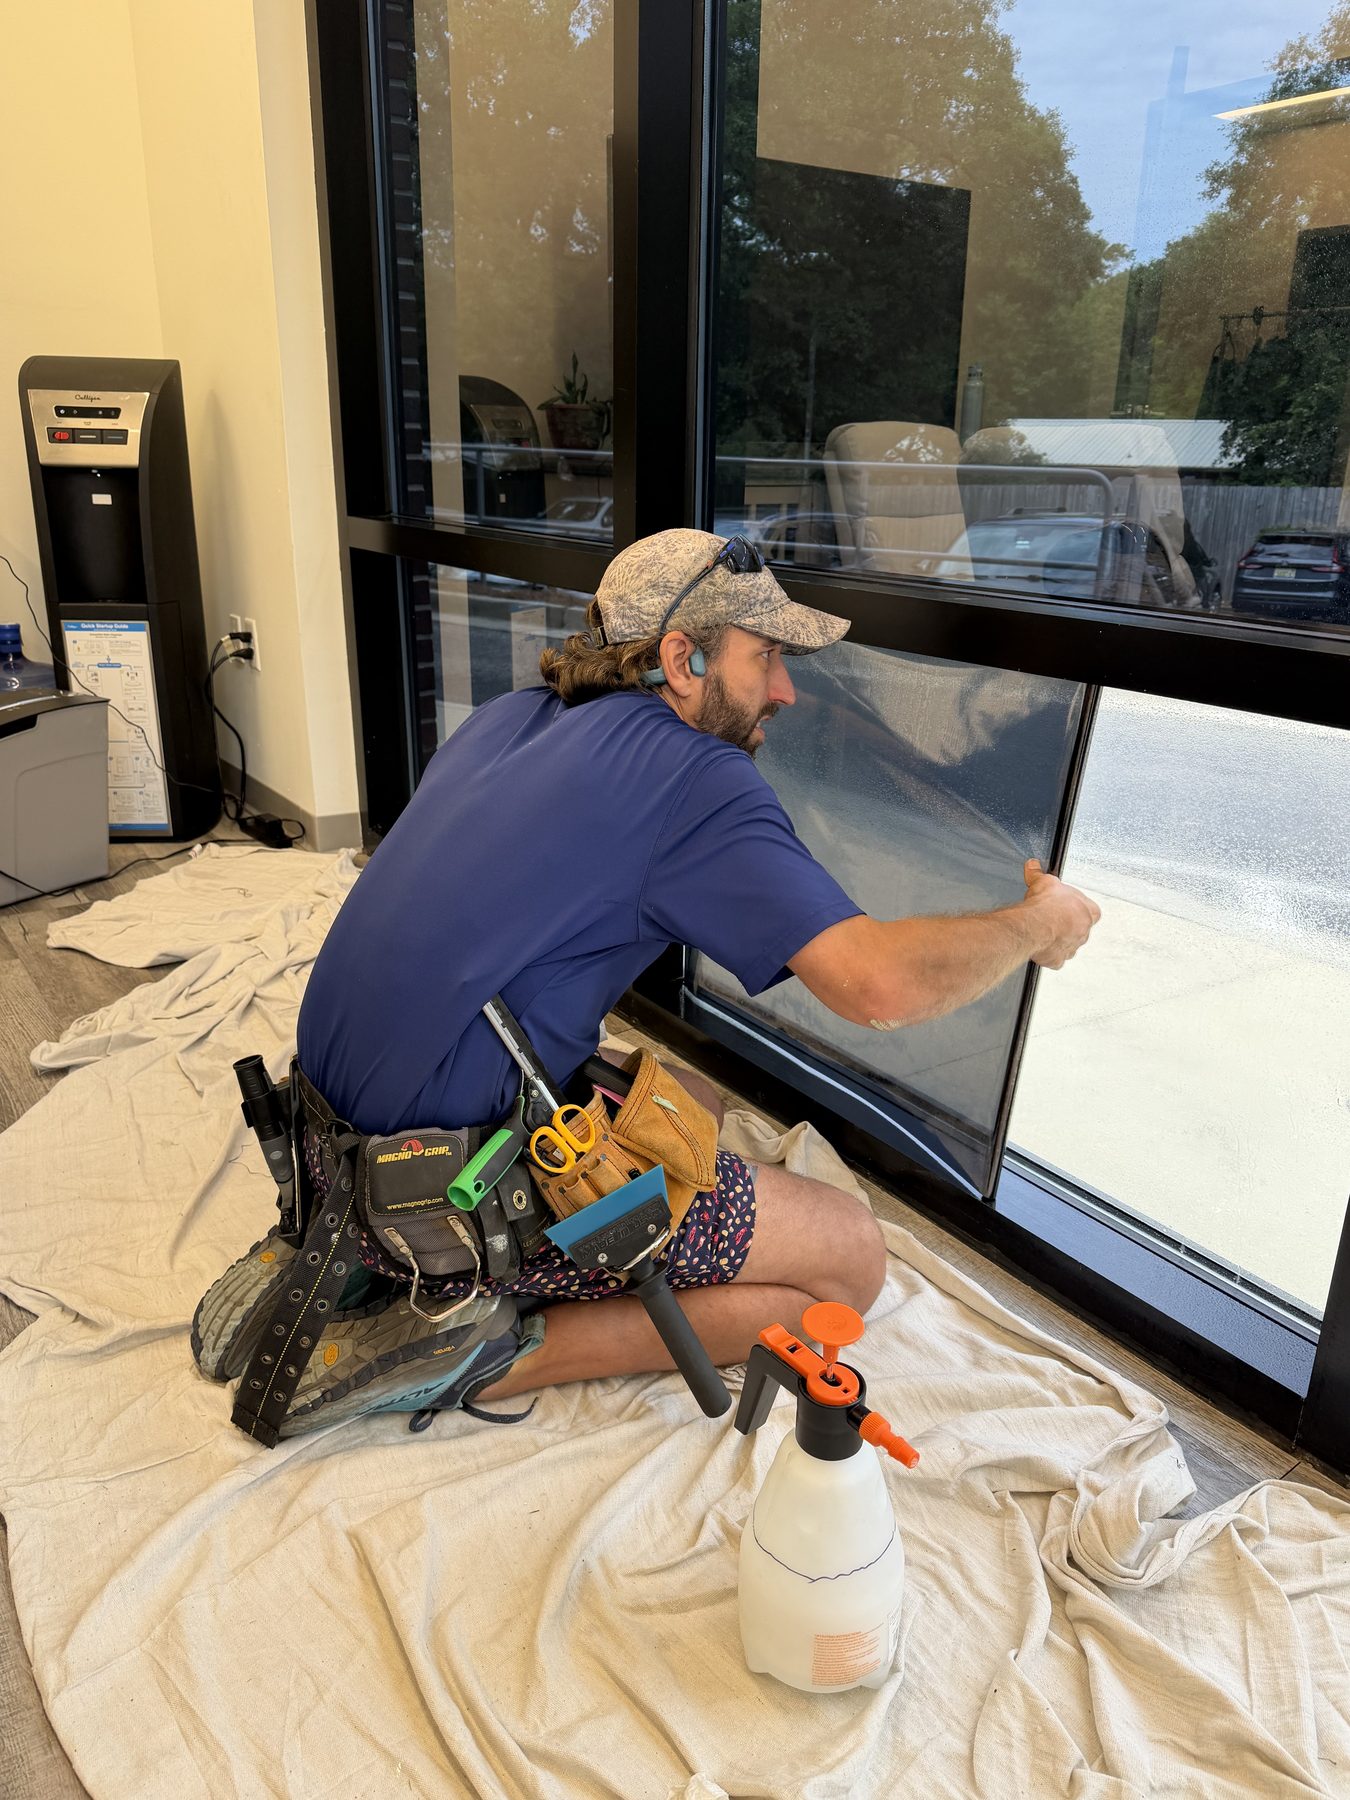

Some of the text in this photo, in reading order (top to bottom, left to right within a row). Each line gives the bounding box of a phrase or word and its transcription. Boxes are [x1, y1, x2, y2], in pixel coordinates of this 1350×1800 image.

[376, 1150, 413, 1164] MAGNO
[424, 1145, 450, 1157] GRIP
[386, 1197, 444, 1210] www.magnogrip.com
